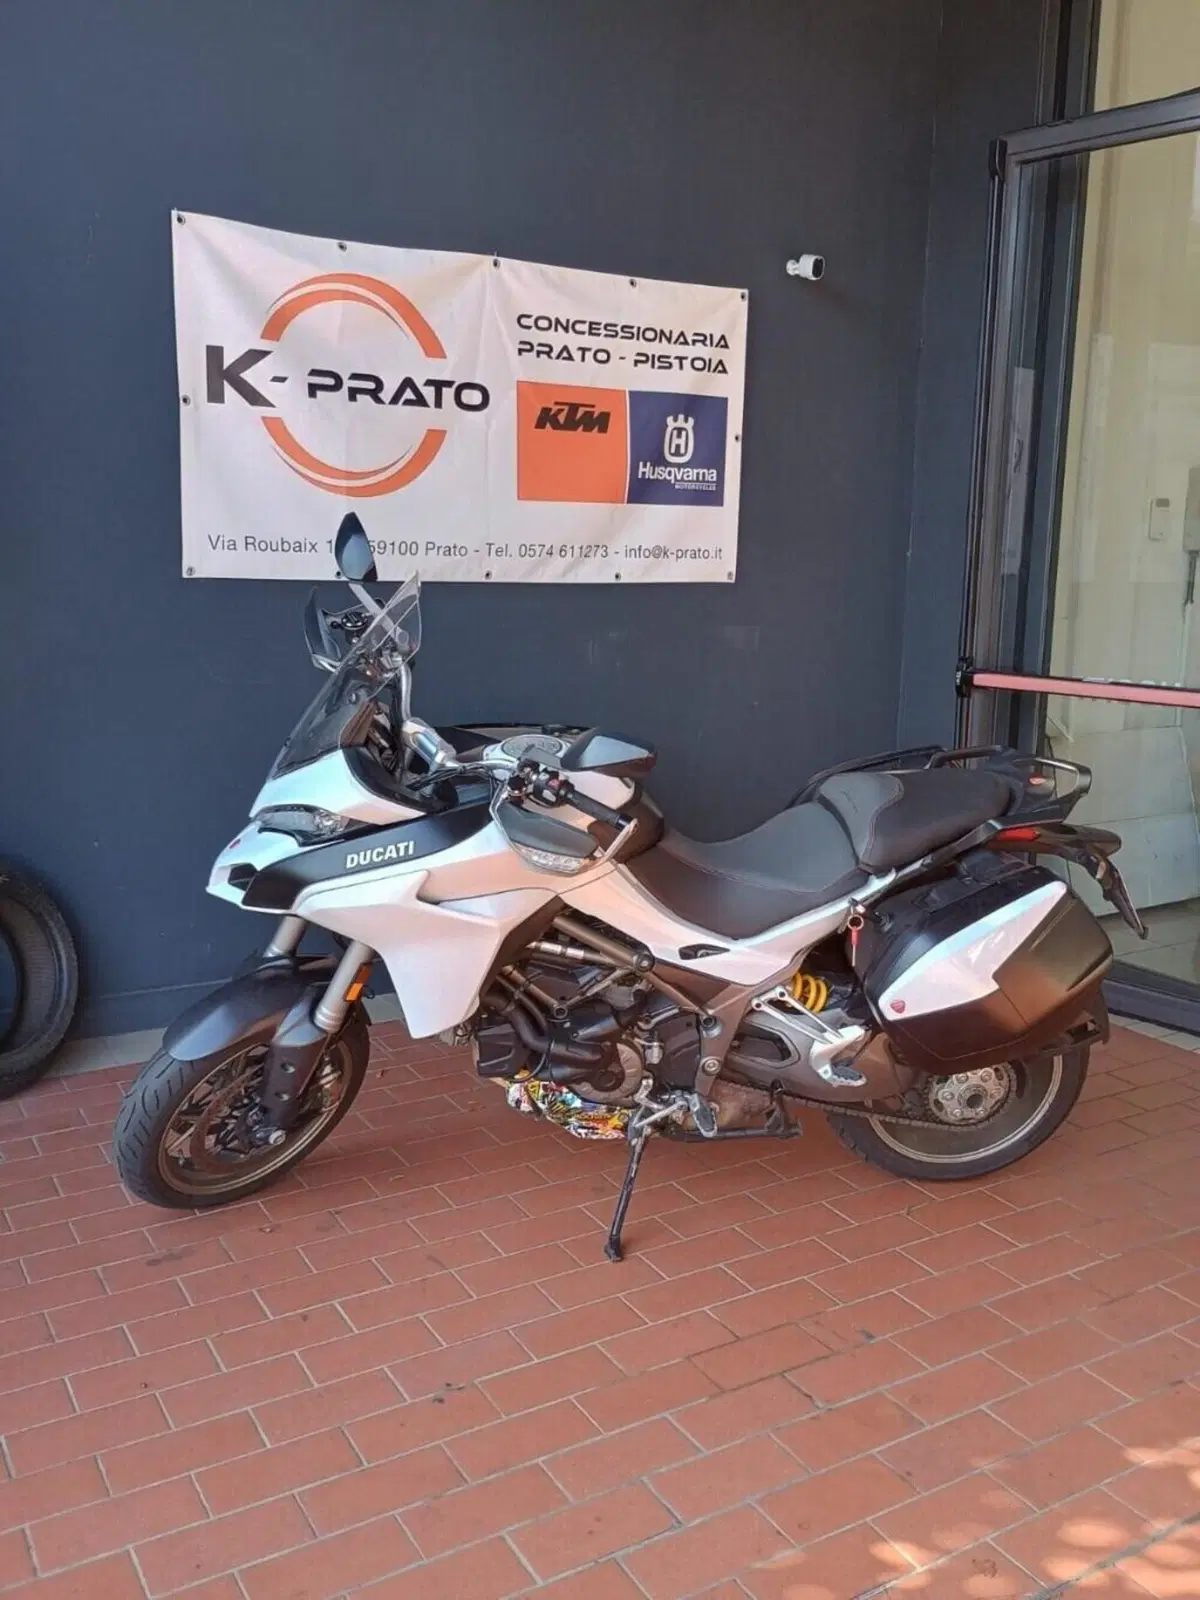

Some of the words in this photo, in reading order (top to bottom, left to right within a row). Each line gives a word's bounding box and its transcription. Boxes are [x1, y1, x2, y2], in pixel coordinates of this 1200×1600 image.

[516, 313, 730, 350] CONCESSIONARIA
[517, 340, 611, 365] PRATO
[633, 351, 729, 375] PISTOIA
[307, 368, 490, 412] PRATO
[534, 401, 611, 434] KTM
[637, 461, 717, 484] Husqvarna
[208, 534, 237, 551] Via
[244, 535, 318, 553] Roubaix
[425, 540, 468, 557] Prato
[485, 542, 512, 558] Tel.
[518, 543, 554, 558] 0574
[559, 544, 609, 559] 611273
[624, 544, 722, 561] info@k-prato.it
[346, 840, 415, 869] DUCATI
